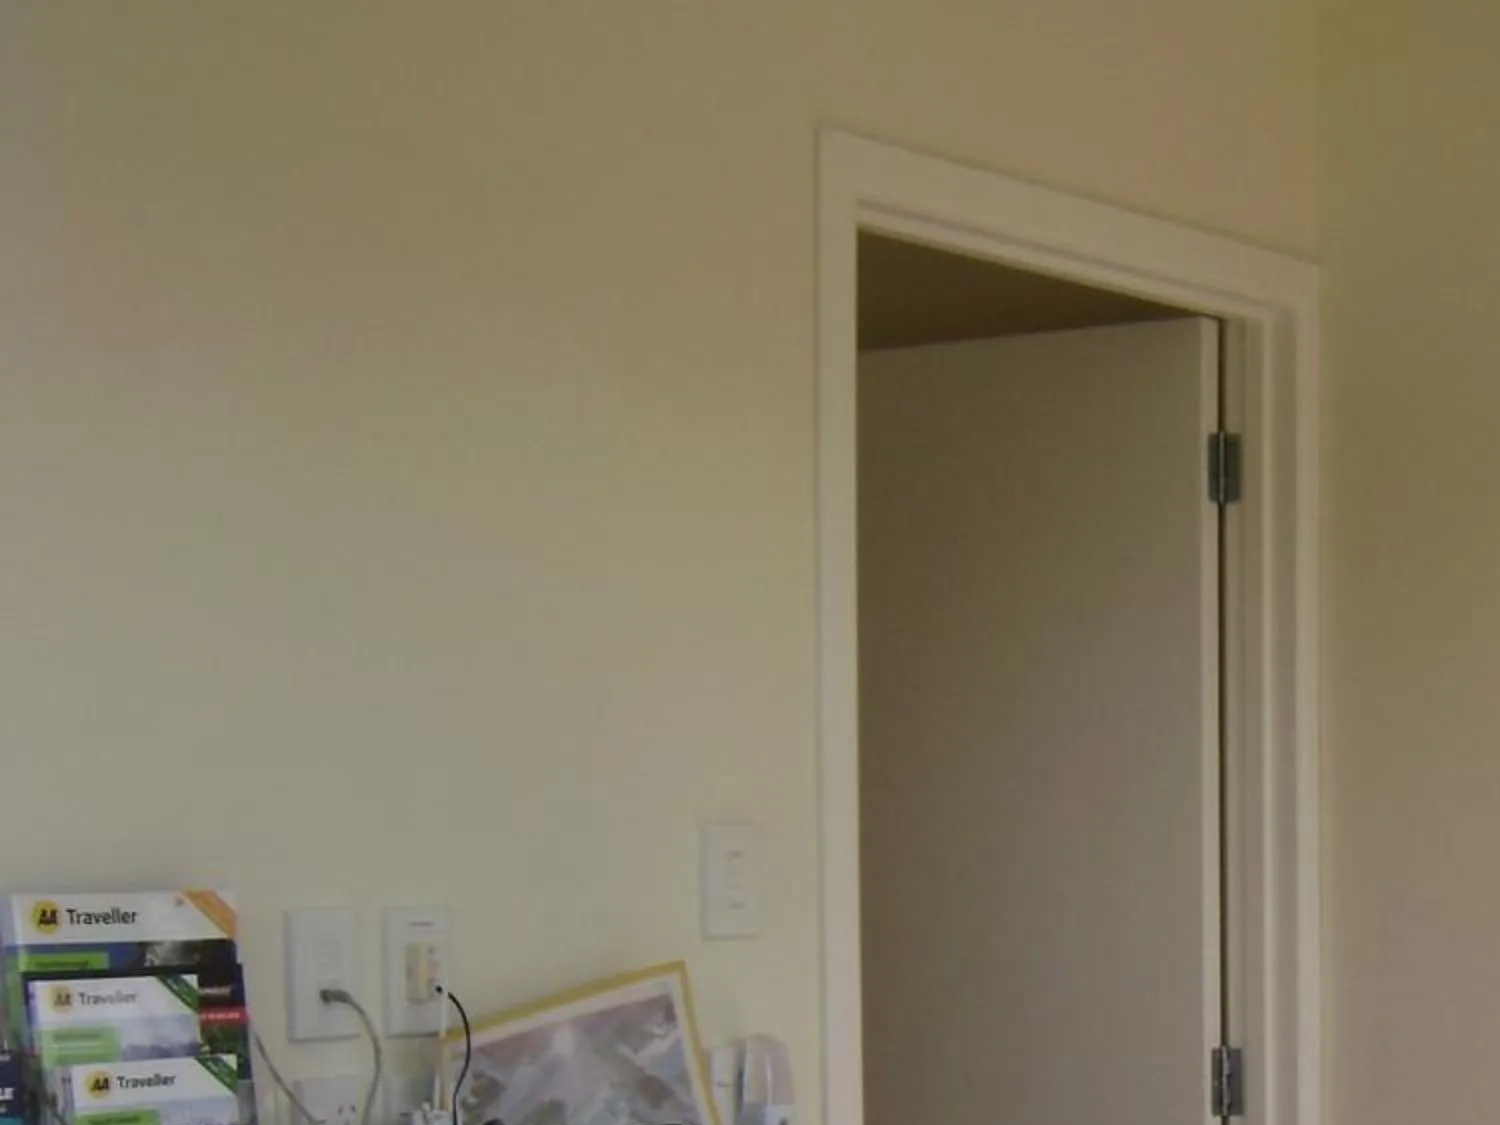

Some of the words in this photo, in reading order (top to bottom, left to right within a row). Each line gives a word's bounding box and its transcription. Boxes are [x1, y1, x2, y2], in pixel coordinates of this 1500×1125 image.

[66, 908, 138, 926] Traveller
[79, 990, 138, 1007] Traveller
[116, 1073, 176, 1091] Traveller
